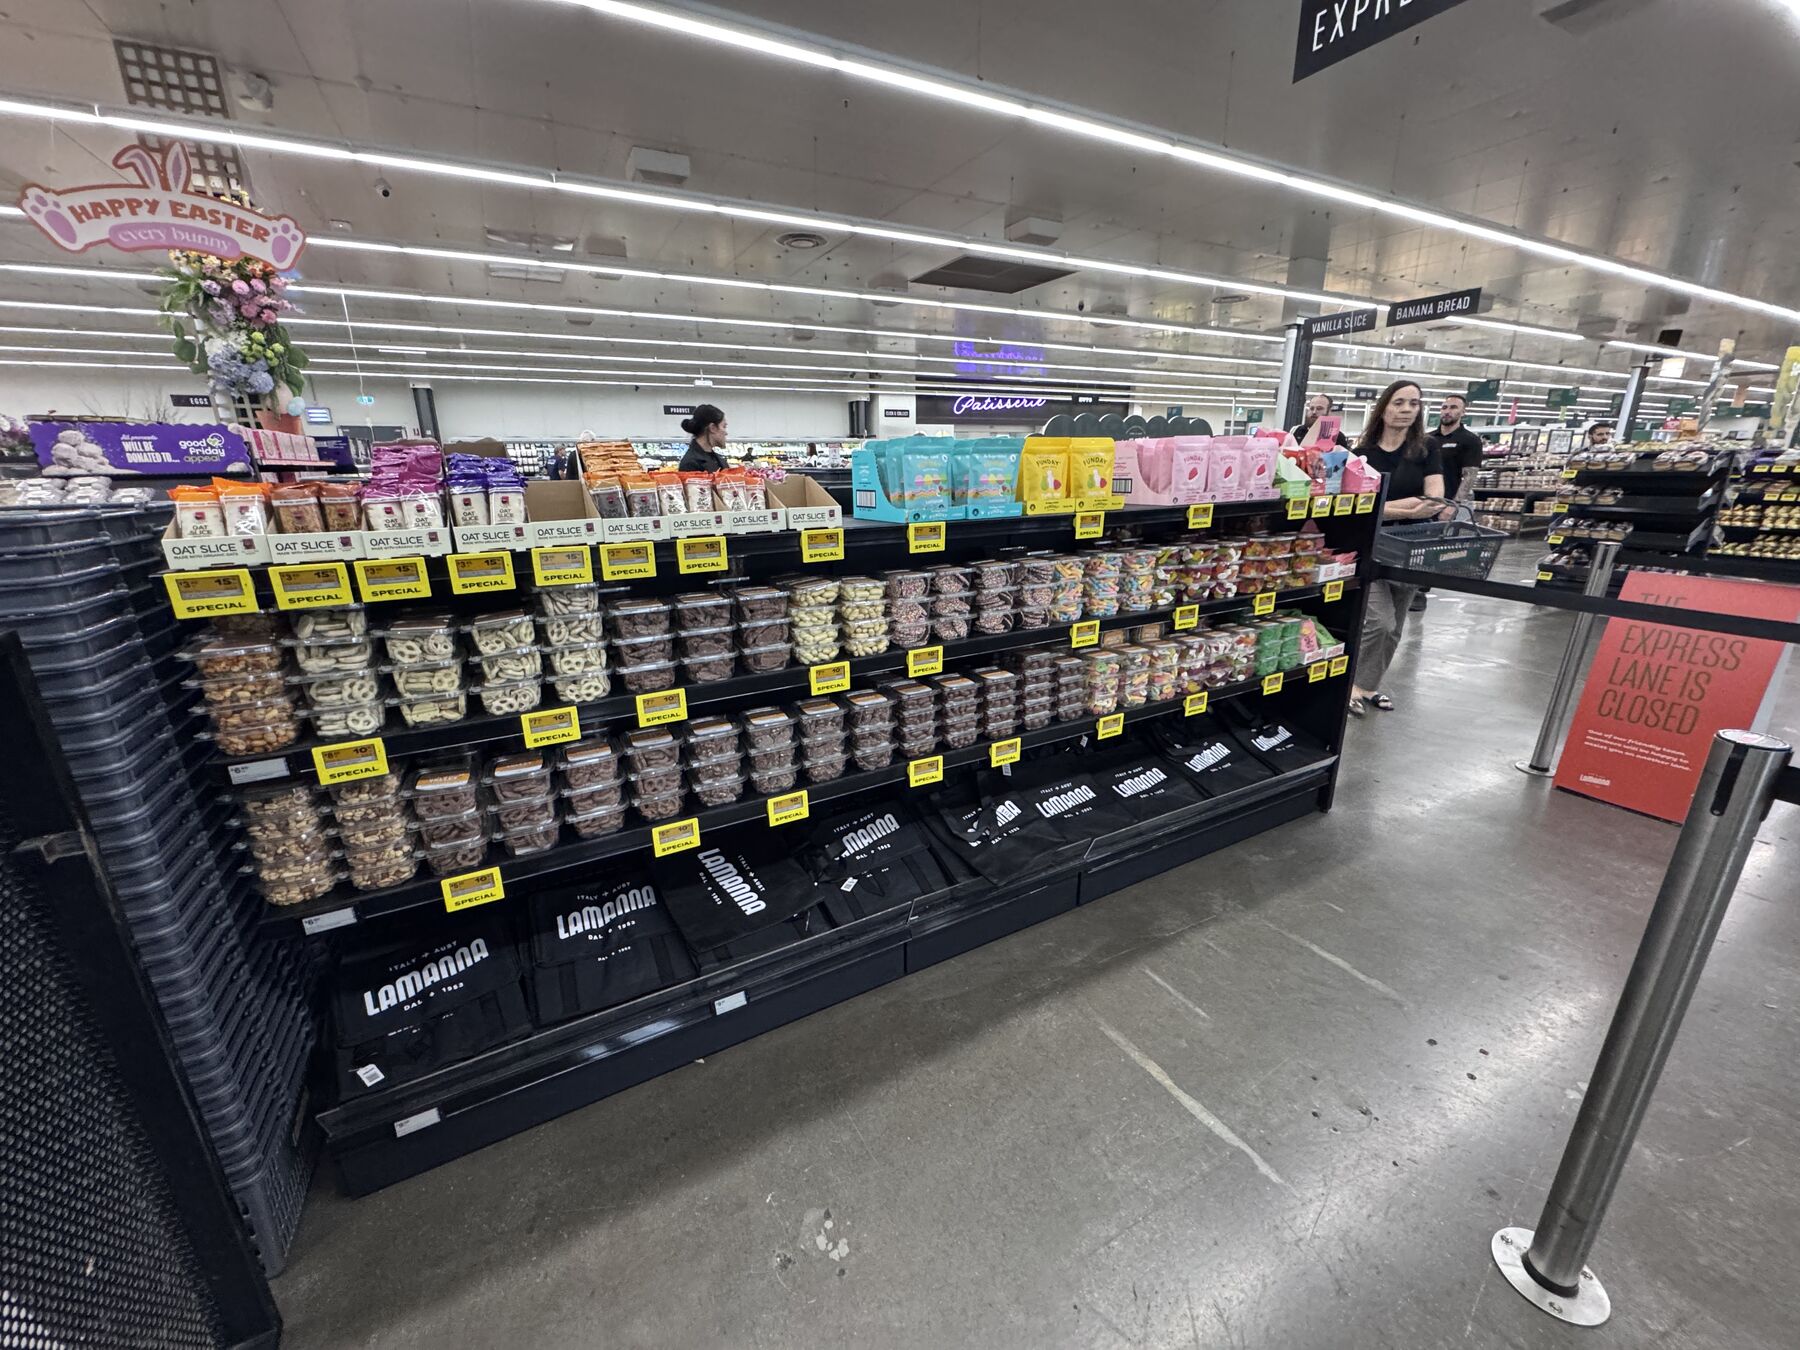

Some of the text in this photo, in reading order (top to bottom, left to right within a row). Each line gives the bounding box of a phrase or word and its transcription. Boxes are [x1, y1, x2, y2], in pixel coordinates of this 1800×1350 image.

[67, 198, 271, 243] HAPPY EASTER
[117, 225, 232, 251] every bunny
[1395, 296, 1470, 320] BANANA BREAD
[1311, 313, 1367, 334] VANILLA SLICE
[953, 395, 1047, 415] Patisserie
[121, 441, 155, 452] WILL BE
[178, 436, 206, 449] good
[189, 446, 225, 457] friday
[126, 451, 161, 464] DONATED
[184, 454, 220, 463] appeal
[1036, 458, 1060, 467] FUNDAY
[1083, 457, 1107, 466] FUNDAY
[689, 519, 711, 527] SLICE
[747, 515, 768, 523] SLICE
[537, 526, 581, 536] OAT SLICE
[608, 524, 624, 533] OAT
[625, 523, 649, 531] SLICE
[370, 535, 423, 547] OAT SLICE
[461, 531, 510, 542] OAT SLICE
[171, 543, 237, 555] OAT SLICE
[275, 540, 334, 551] OAT SLICE
[809, 551, 838, 559] SPECIAL
[686, 561, 721, 570] SPECIAL
[543, 573, 585, 581] SPECIAL
[610, 568, 649, 576] SPECIAL
[461, 579, 507, 589] SPECIAL
[371, 587, 421, 597] SPECIAL
[287, 593, 342, 604] SPECIAL
[186, 602, 246, 613] SPECIAL
[1620, 625, 1747, 671] EXPRESS
[913, 665, 938, 674] SPECIAL
[1608, 656, 1713, 702] LANE IS
[817, 682, 845, 691] SPECIAL
[1597, 688, 1700, 735] CLOSED
[646, 712, 681, 723] SPECIAL
[533, 732, 573, 743] SPECIAL
[328, 766, 380, 780] SPECIAL
[914, 774, 938, 784] SPECIAL
[1112, 767, 1167, 798] LAMANNA
[1035, 785, 1096, 818] LAMANNA
[775, 811, 804, 822] SPECIAL
[661, 840, 694, 853] SPECIAL
[738, 854, 751, 870] ITALY
[697, 847, 767, 916] LAMANNA
[699, 871, 708, 884] DAL
[454, 892, 497, 907] SPECIAL
[556, 885, 657, 940] LAMANNA
[388, 940, 457, 972] ITALY AUST
[363, 937, 489, 1017] LAMANNA
[403, 1000, 423, 1011] DAL
